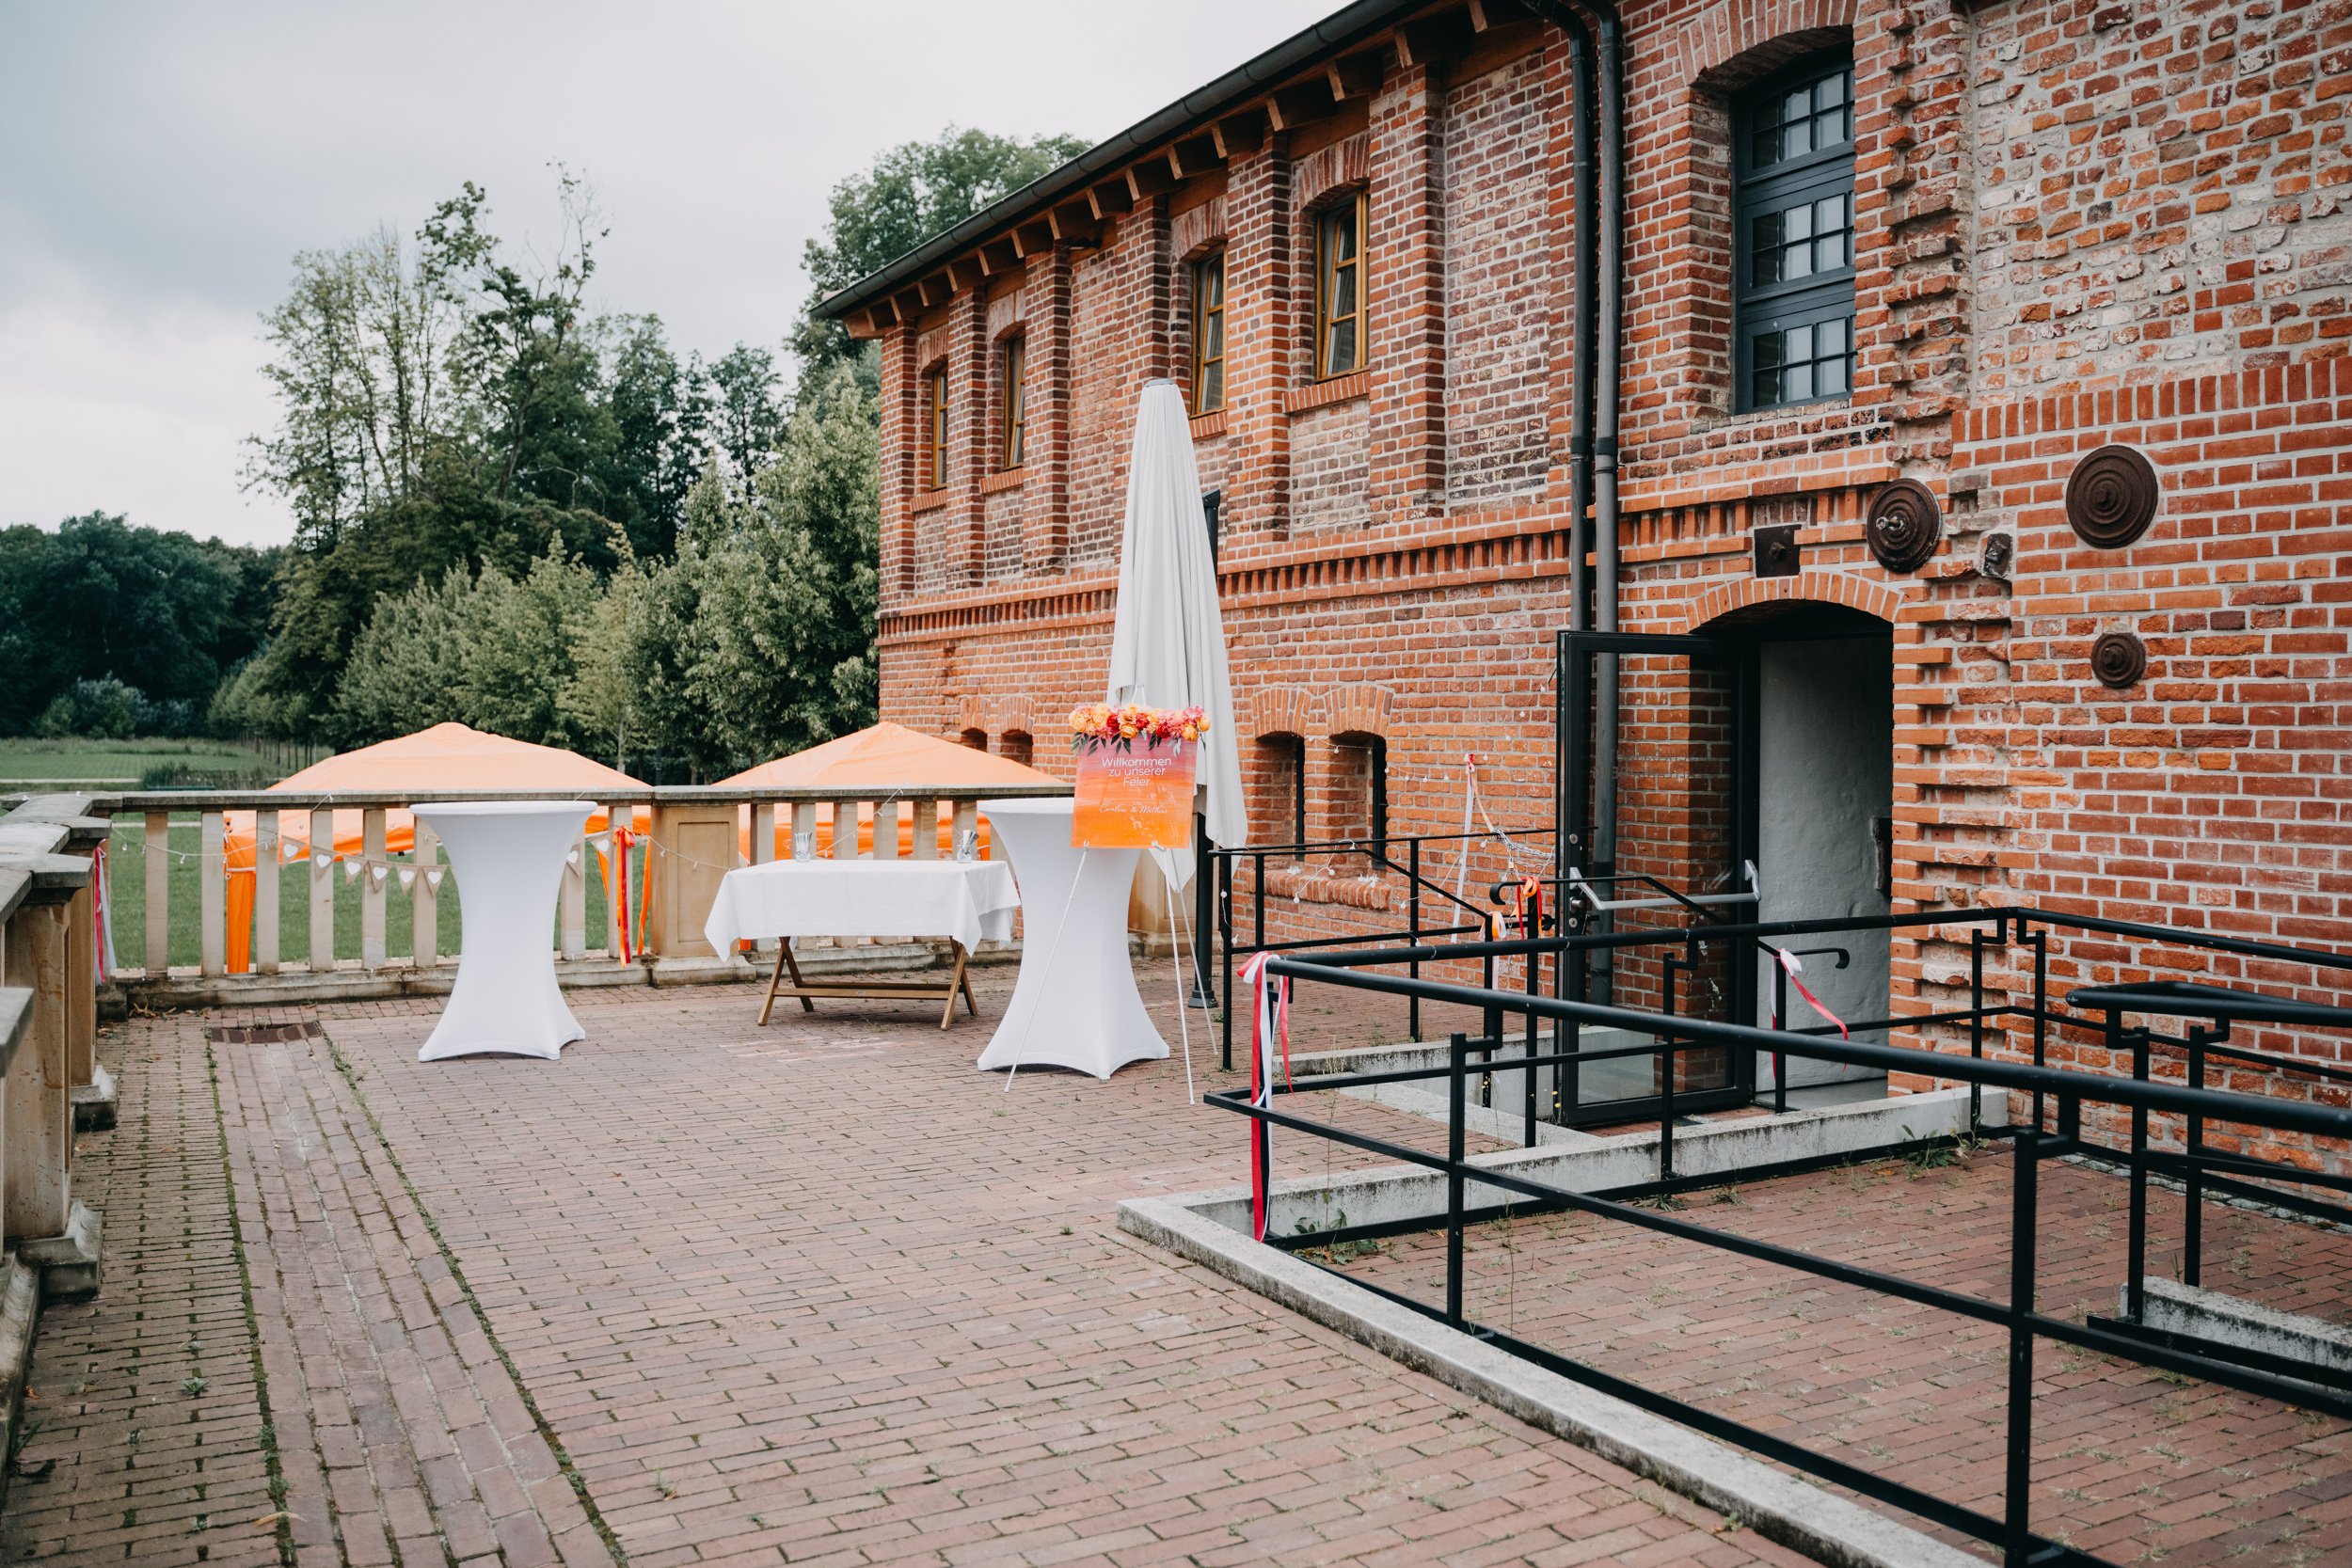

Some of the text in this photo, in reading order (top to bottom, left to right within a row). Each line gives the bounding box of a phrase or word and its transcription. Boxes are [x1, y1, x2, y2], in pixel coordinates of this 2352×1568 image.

[1102, 757, 1171, 768] Willkommen
[1124, 768, 1166, 776] unserer
[1123, 777, 1150, 786] Feier
